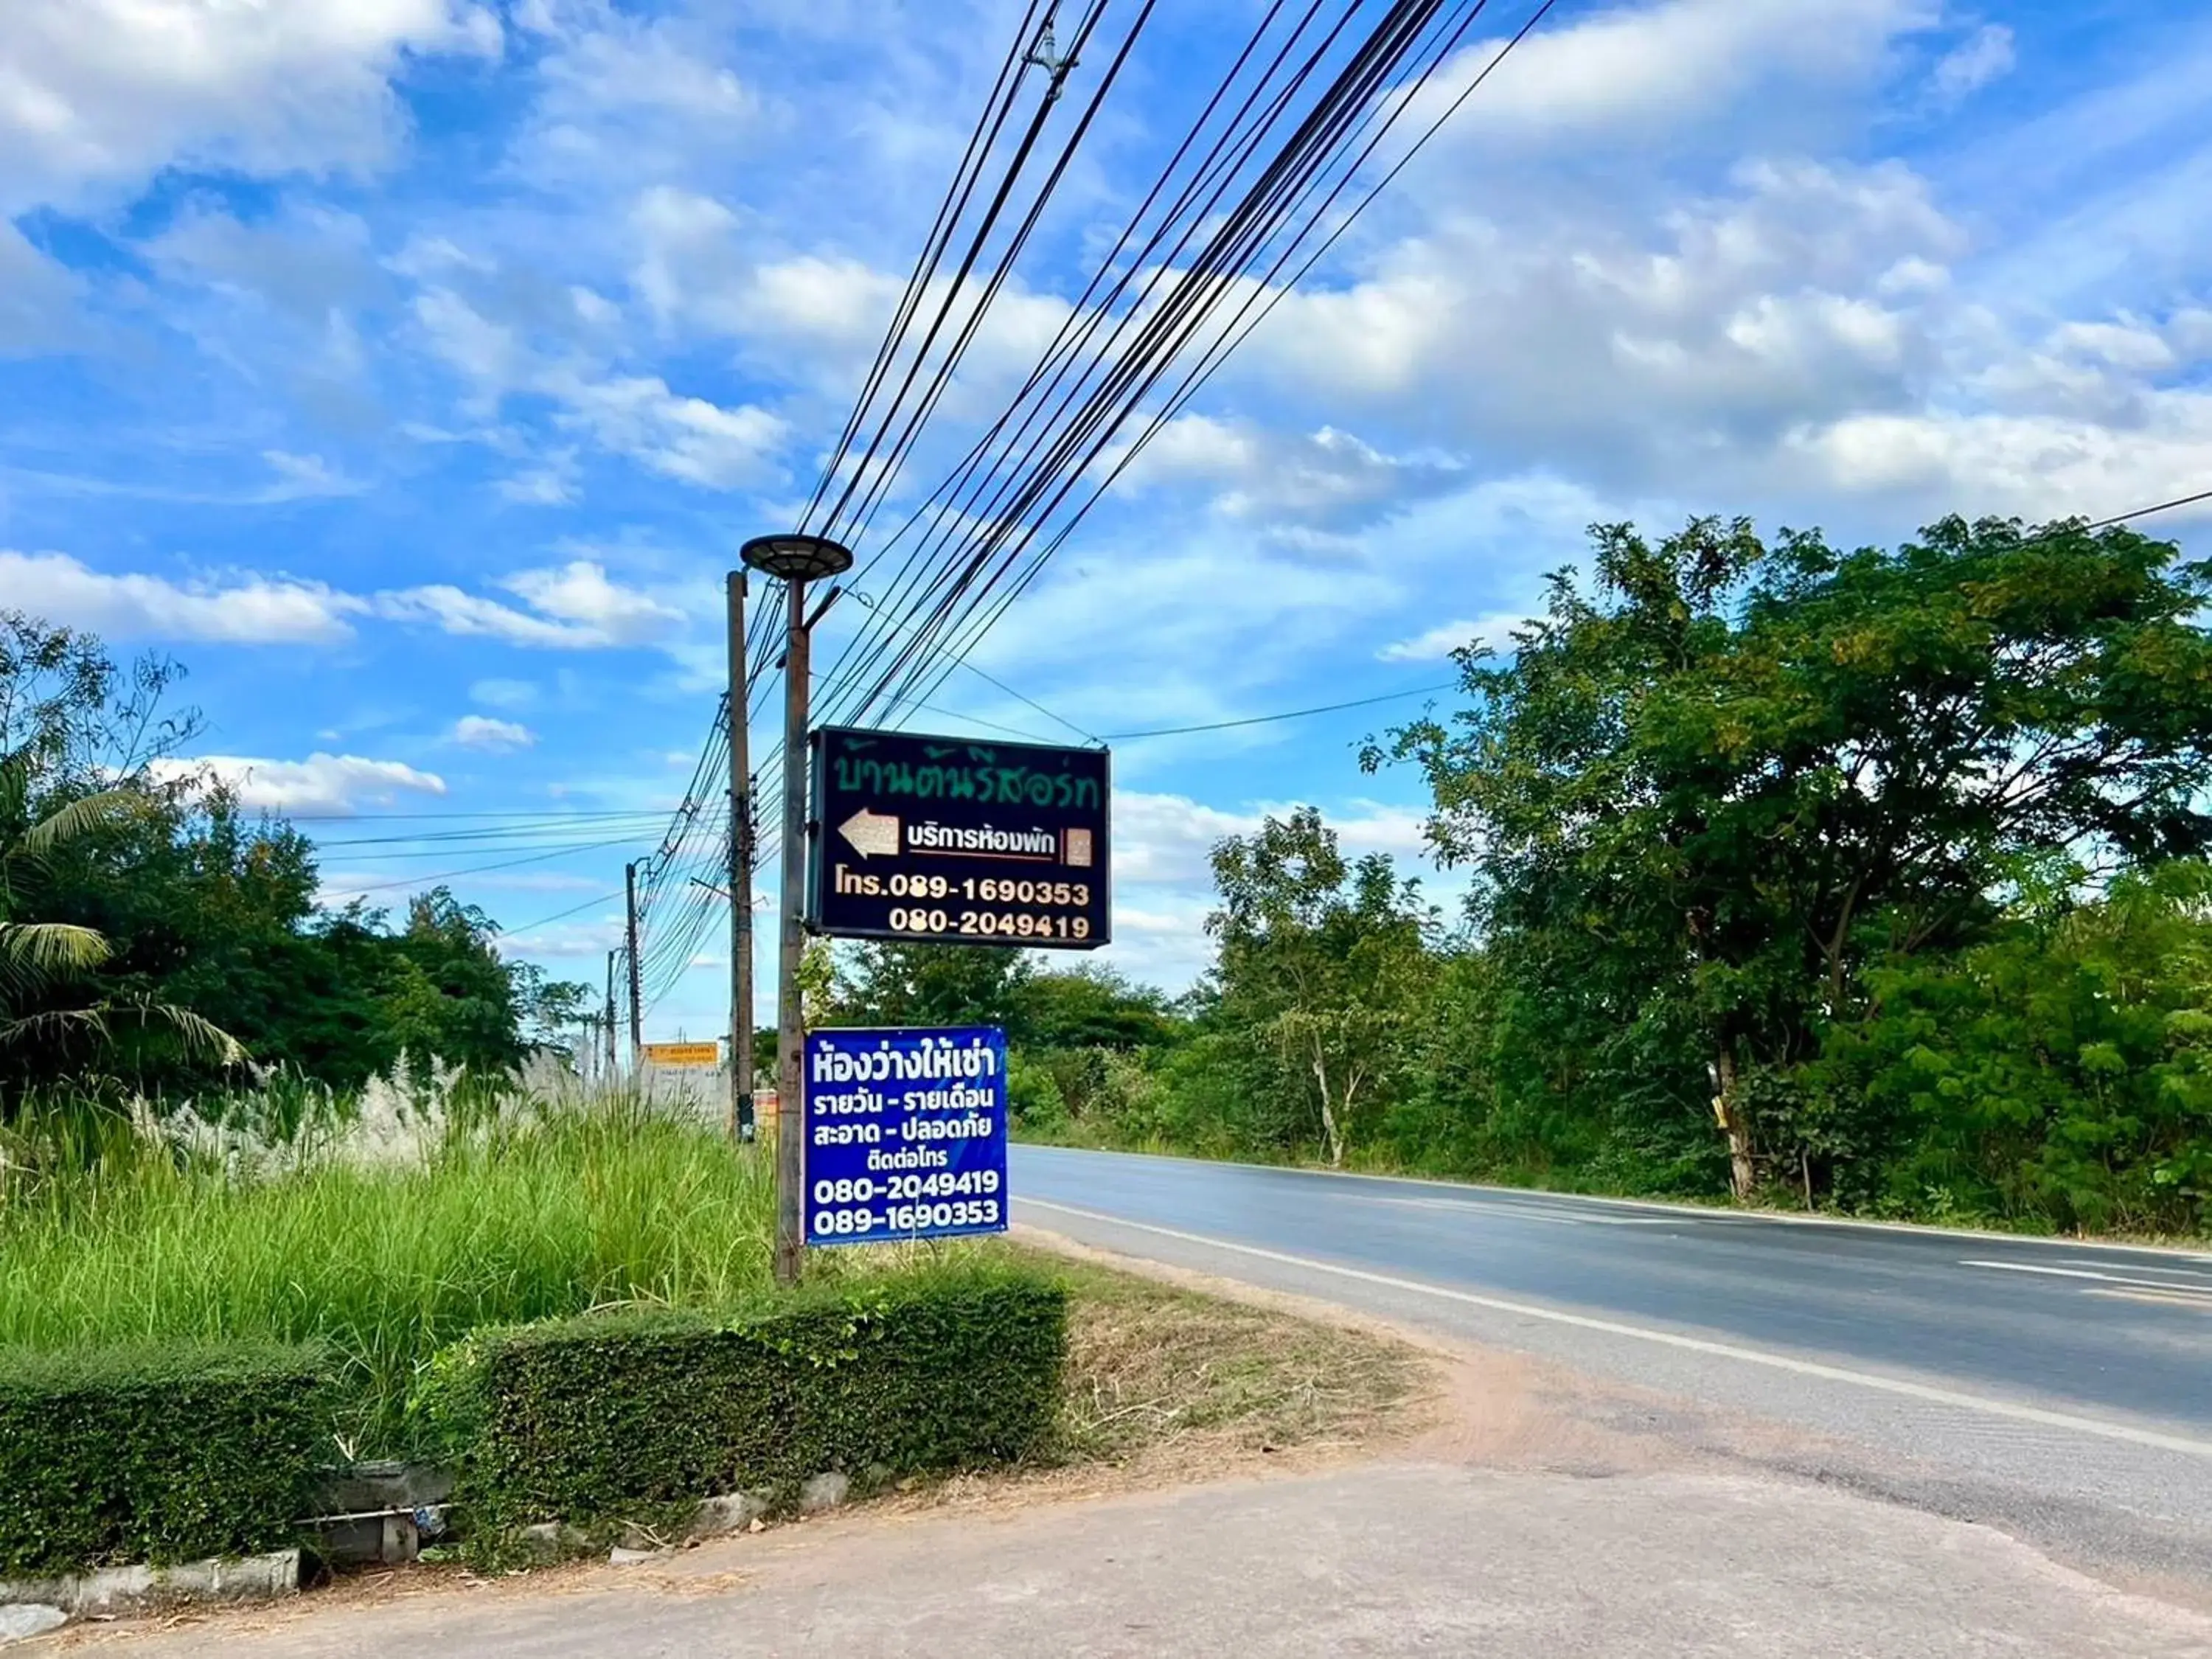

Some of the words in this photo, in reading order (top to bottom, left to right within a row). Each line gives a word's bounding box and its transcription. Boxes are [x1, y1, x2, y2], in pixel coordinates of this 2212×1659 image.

[908, 820, 1056, 855] บริการห้องพัก
[889, 908, 1090, 939] 080-2049419
[813, 1037, 995, 1082] ห้องว่างให้เช่า
[813, 1086, 883, 1115] รายวัน
[903, 1082, 995, 1111] รายเดือน
[813, 1122, 880, 1146] สะอาด
[901, 1111, 992, 1141] ปลอดภัย
[867, 1144, 948, 1171] ติดต่อโทร
[814, 1169, 1000, 1204] 080-2049419
[814, 1199, 1000, 1235] 089-1690353
